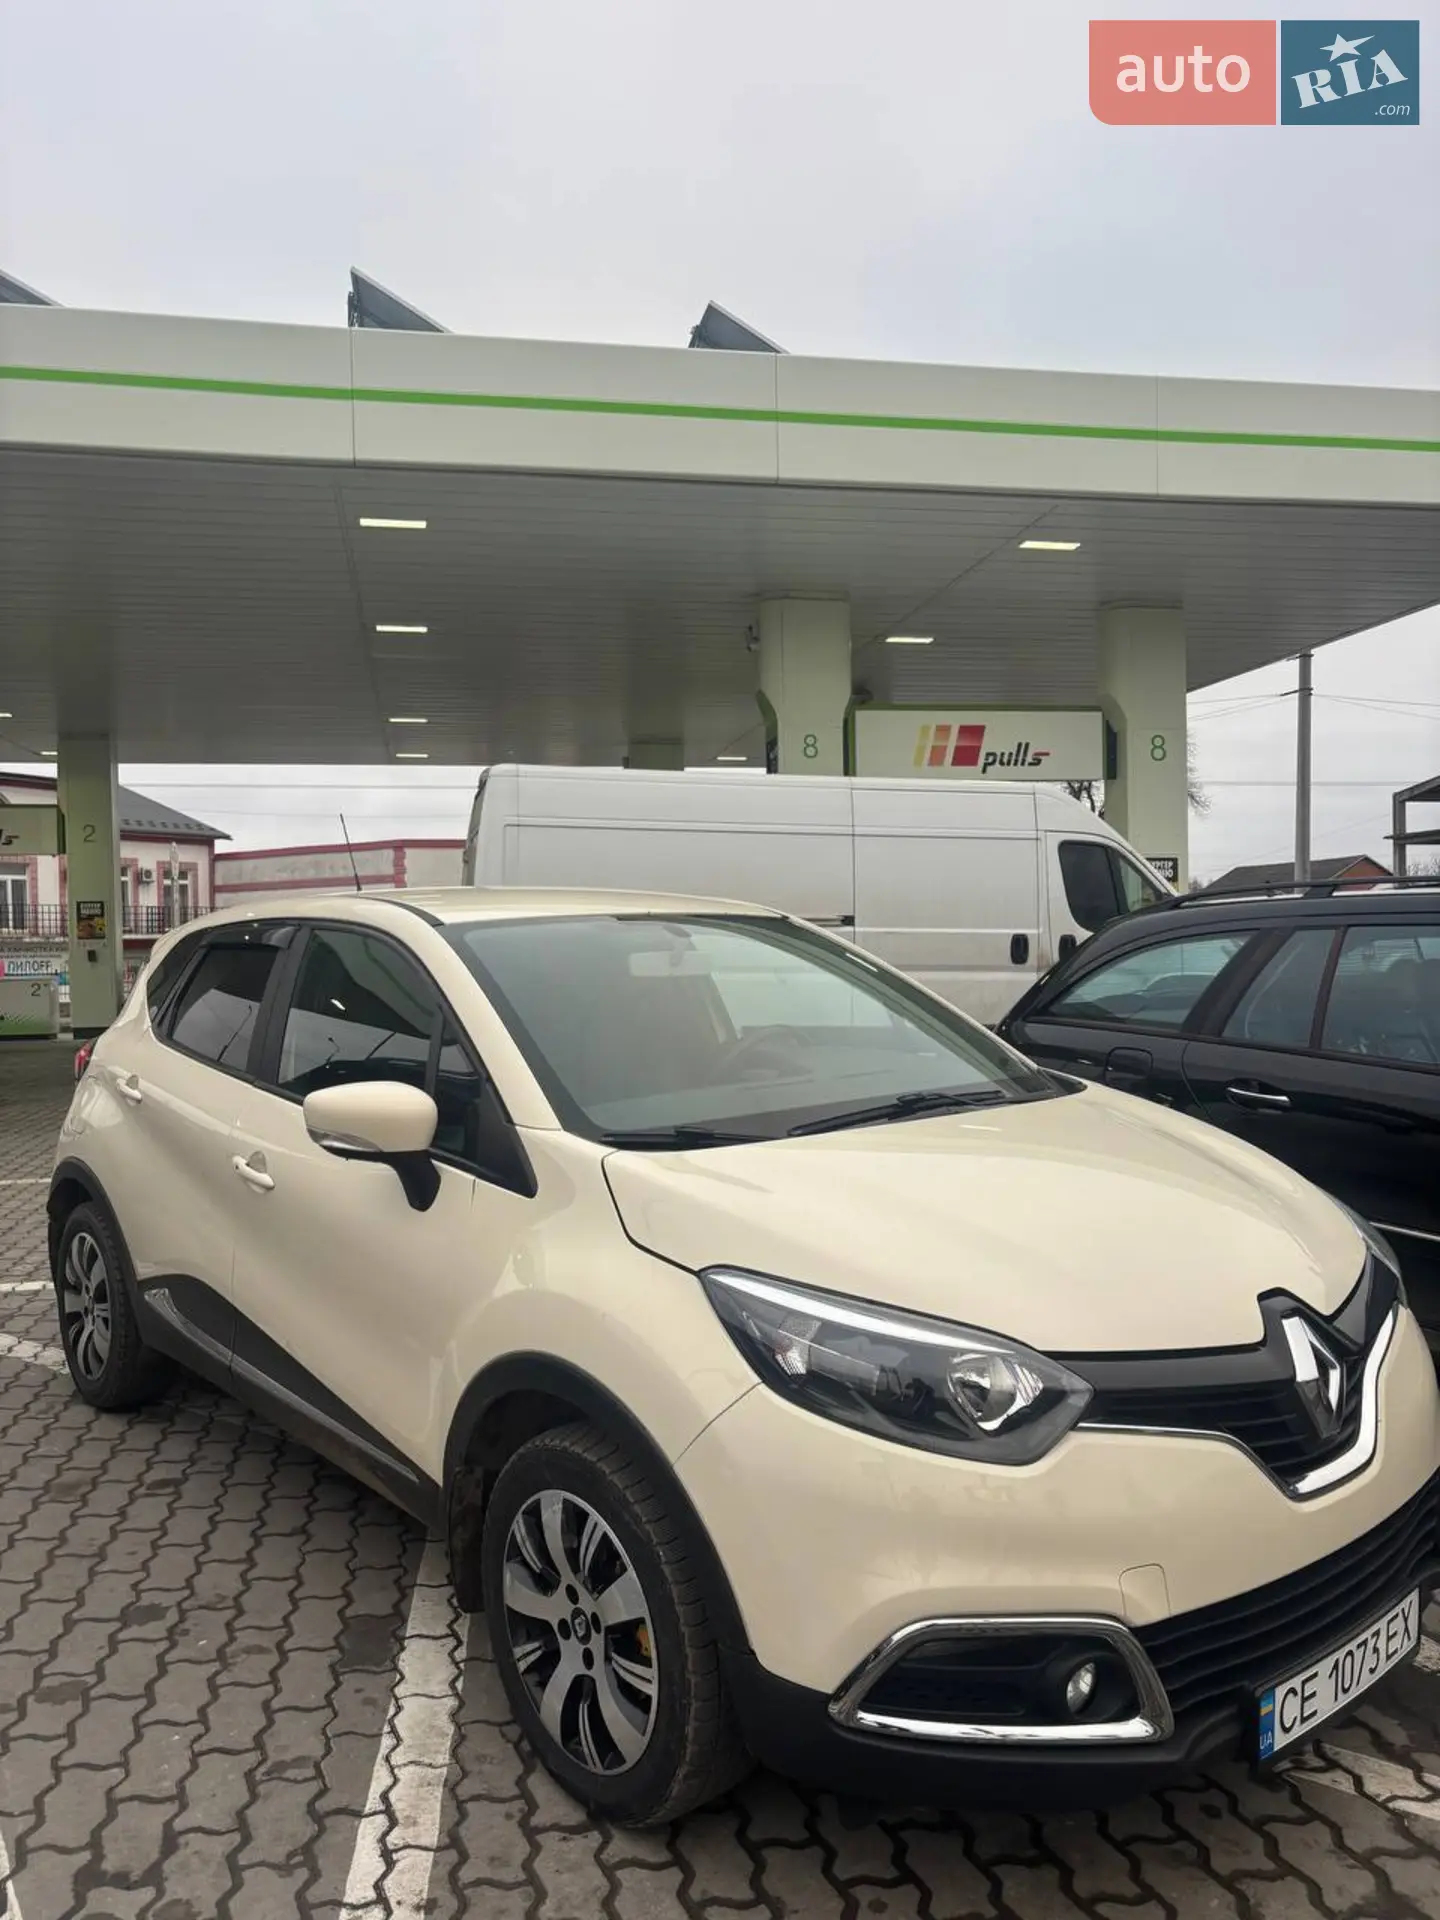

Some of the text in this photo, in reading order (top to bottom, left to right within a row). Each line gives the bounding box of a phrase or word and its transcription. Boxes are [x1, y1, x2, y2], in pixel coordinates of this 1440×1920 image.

[803, 734, 819, 759] 8
[981, 741, 1051, 775] pulls
[1150, 734, 1167, 762] 8
[83, 824, 96, 843] 2
[31, 982, 41, 997] 2
[1279, 1599, 1414, 1735] CE 1073 EX
[1259, 1731, 1273, 1750] UA
